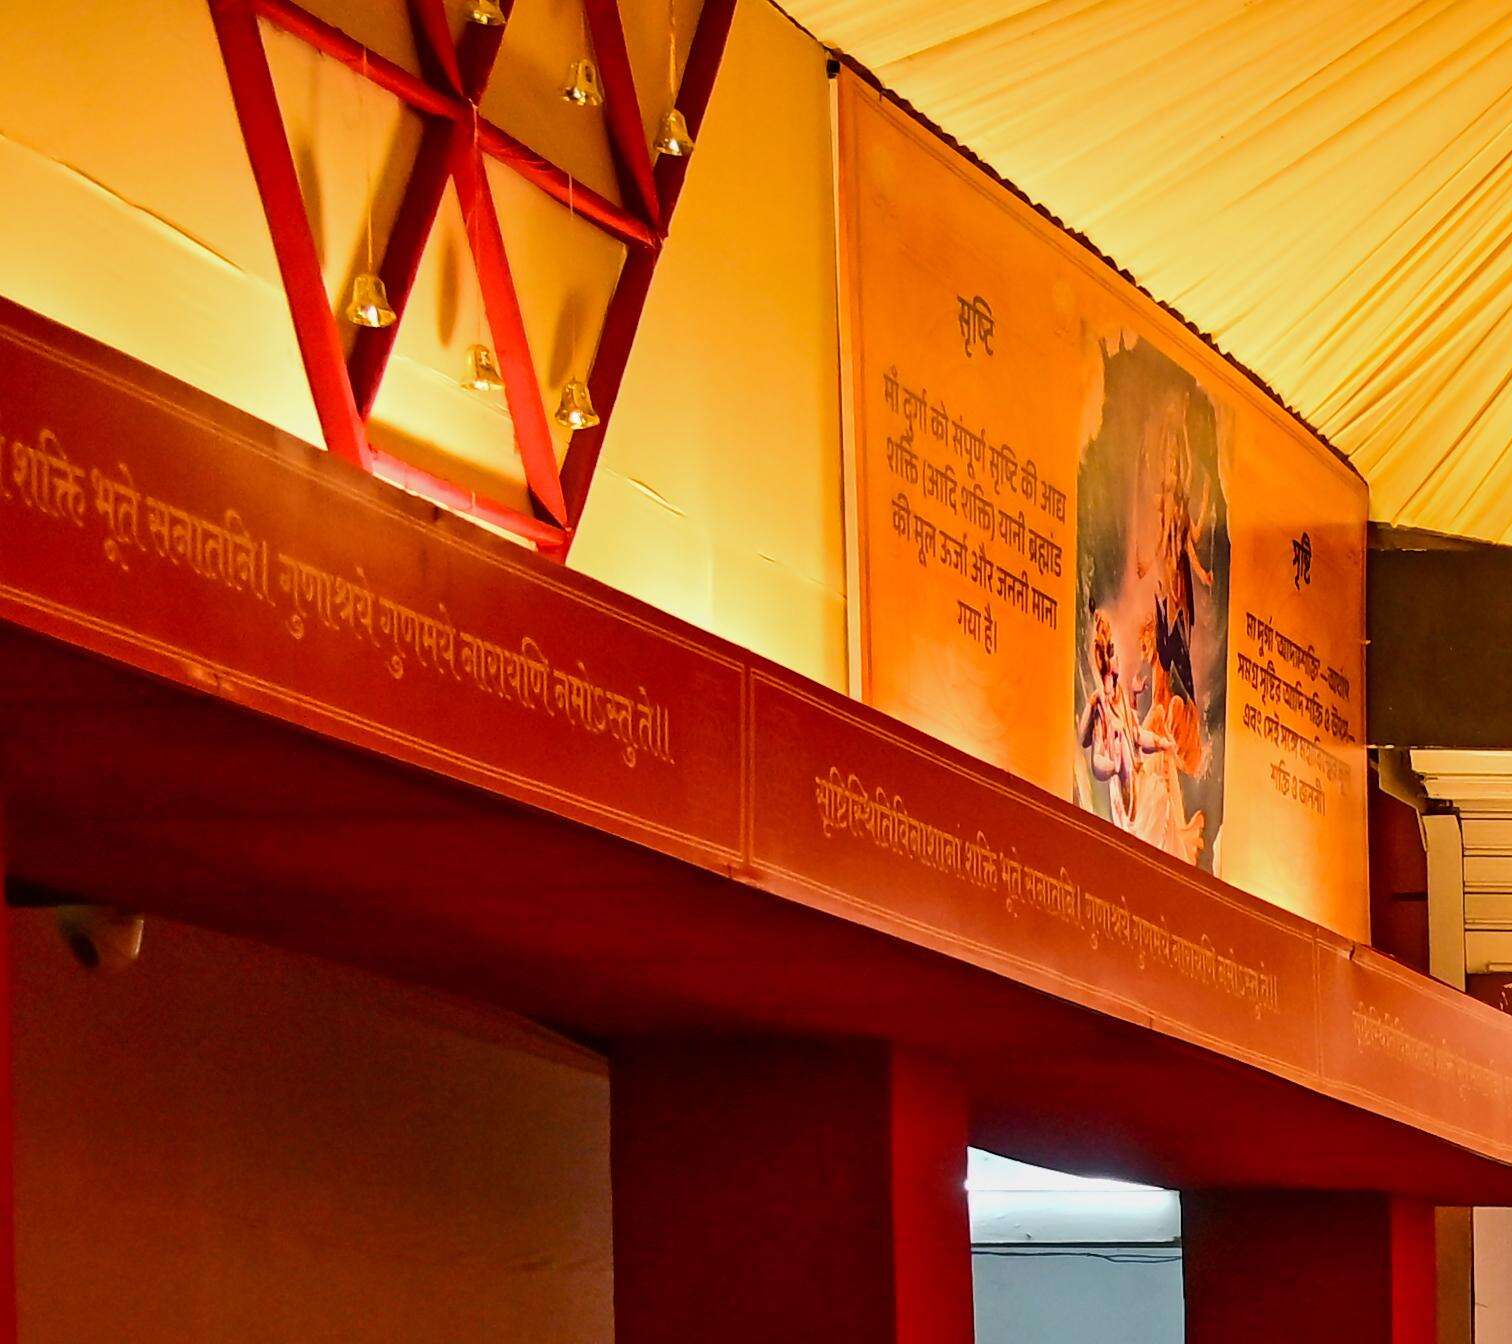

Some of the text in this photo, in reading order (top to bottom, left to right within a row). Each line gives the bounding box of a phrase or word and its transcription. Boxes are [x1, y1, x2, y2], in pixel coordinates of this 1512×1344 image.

[957, 295, 995, 358] सृष्टि
[902, 388, 927, 447] दुर्गा
[930, 400, 949, 447] को
[952, 414, 986, 480] संपूर्ण
[989, 443, 1018, 495] सृष्टि
[1021, 460, 1038, 505] की
[886, 436, 1063, 577] शक्ति (आदि शक्ति) यानी ब्रह्मांड
[892, 492, 1058, 630] की मूल ऊर्जा और जननी माना
[13, 429, 85, 527] शक्ति
[91, 462, 146, 571] भूते
[278, 553, 380, 648] गुणाश्रये
[379, 598, 461, 681] गुणमये
[460, 632, 555, 716] नारायणि
[957, 600, 981, 643] गया
[965, 830, 998, 892] शक्ति
[1000, 847, 1025, 918] भूते
